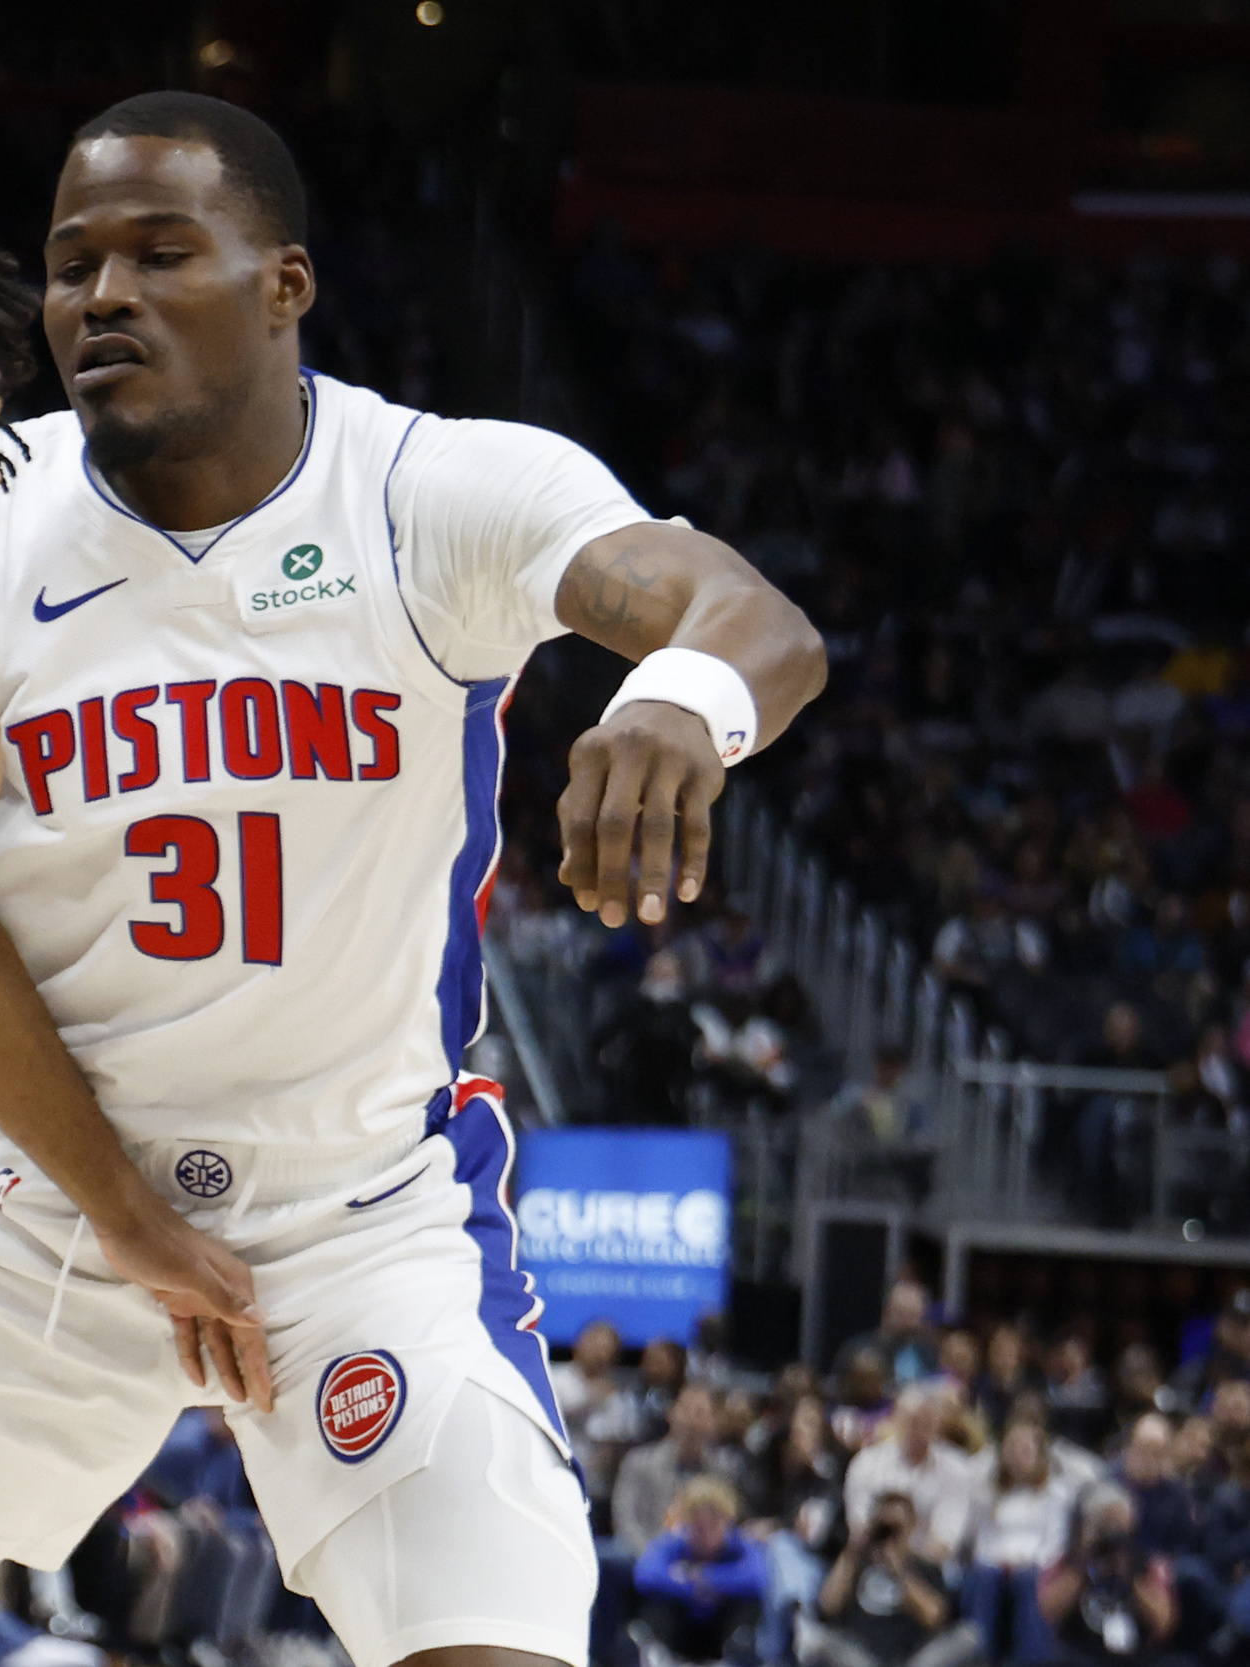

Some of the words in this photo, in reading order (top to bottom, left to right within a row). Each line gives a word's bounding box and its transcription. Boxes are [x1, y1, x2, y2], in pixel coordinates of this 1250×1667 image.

[251, 574, 356, 611] StockX
[6, 677, 402, 816] PISTONS
[124, 811, 283, 967] 31
[330, 1374, 384, 1413] DETROIT
[332, 1393, 387, 1433] PISTONS
